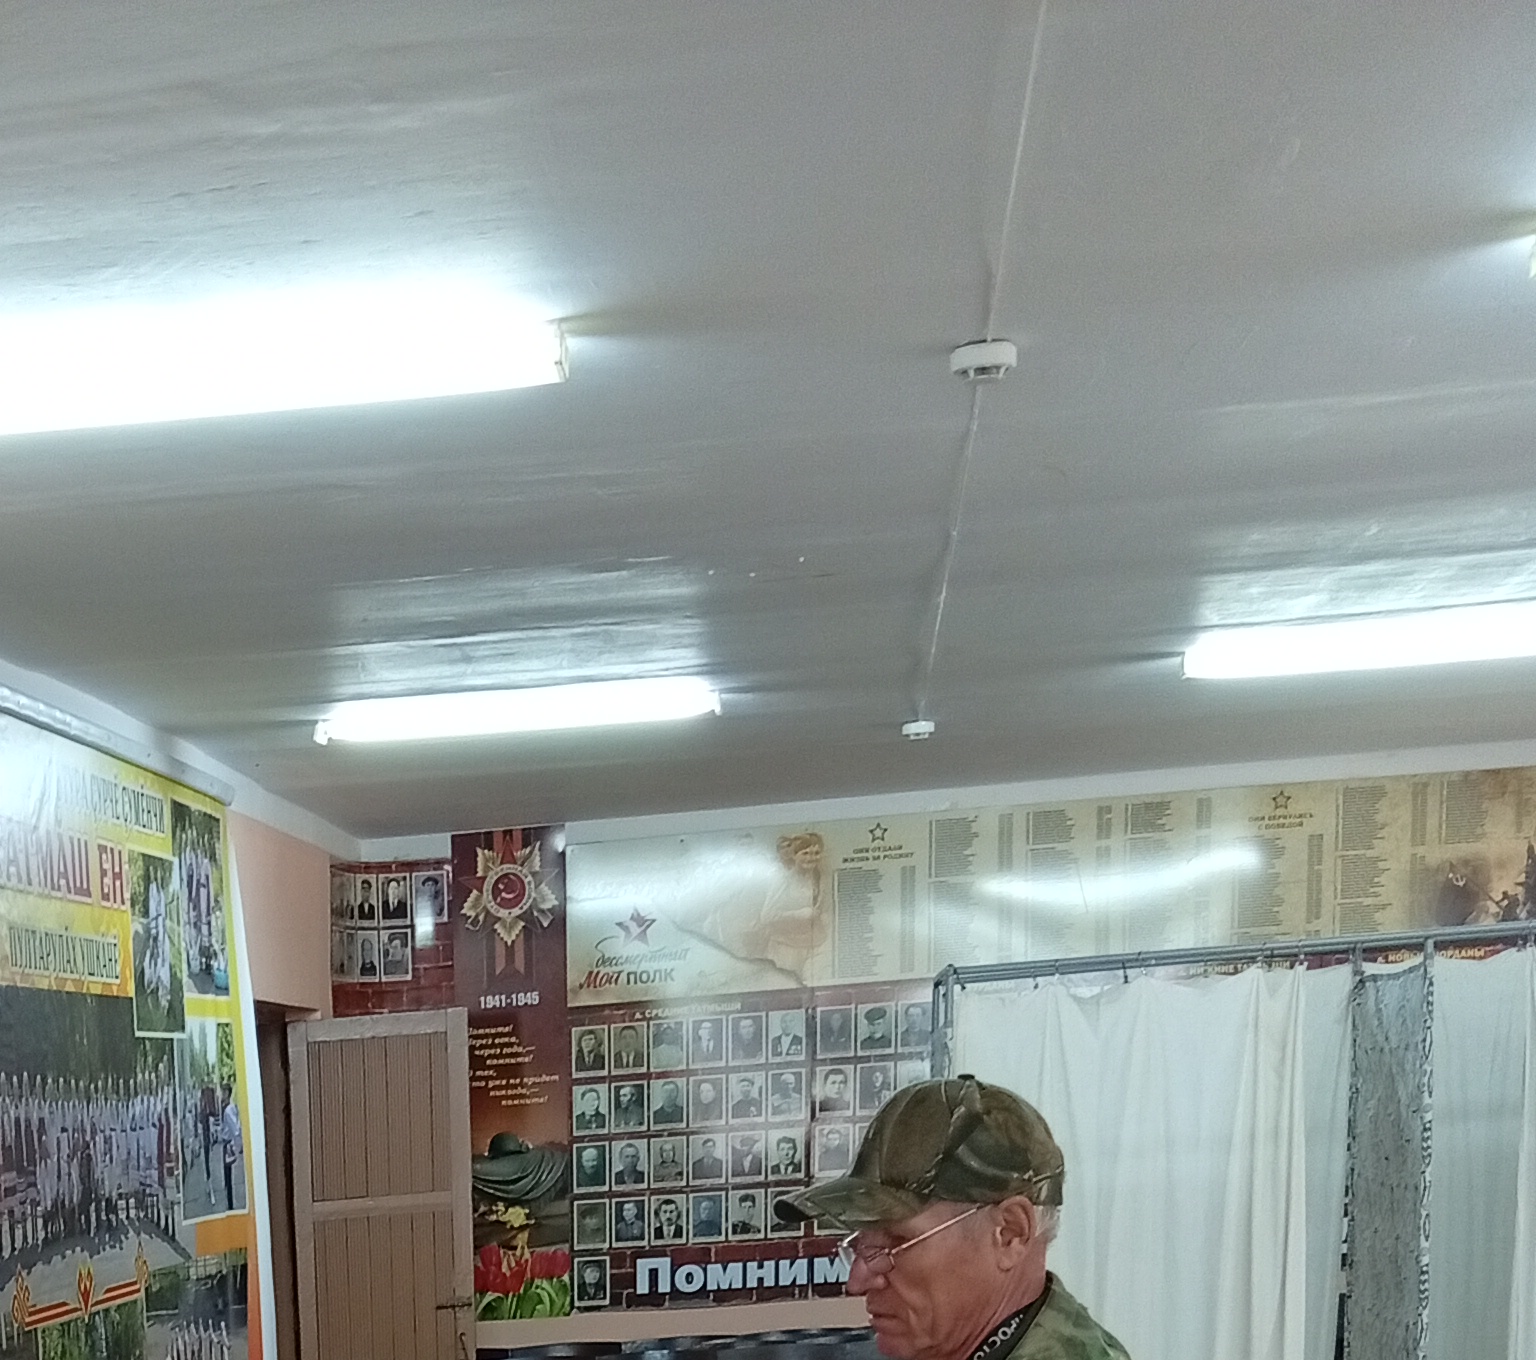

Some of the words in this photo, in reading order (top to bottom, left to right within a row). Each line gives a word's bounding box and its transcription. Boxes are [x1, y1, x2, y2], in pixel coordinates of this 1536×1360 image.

[579, 970, 624, 991] Мой
[480, 992, 540, 1009] 1941-1945
[636, 1256, 851, 1295] Помним
